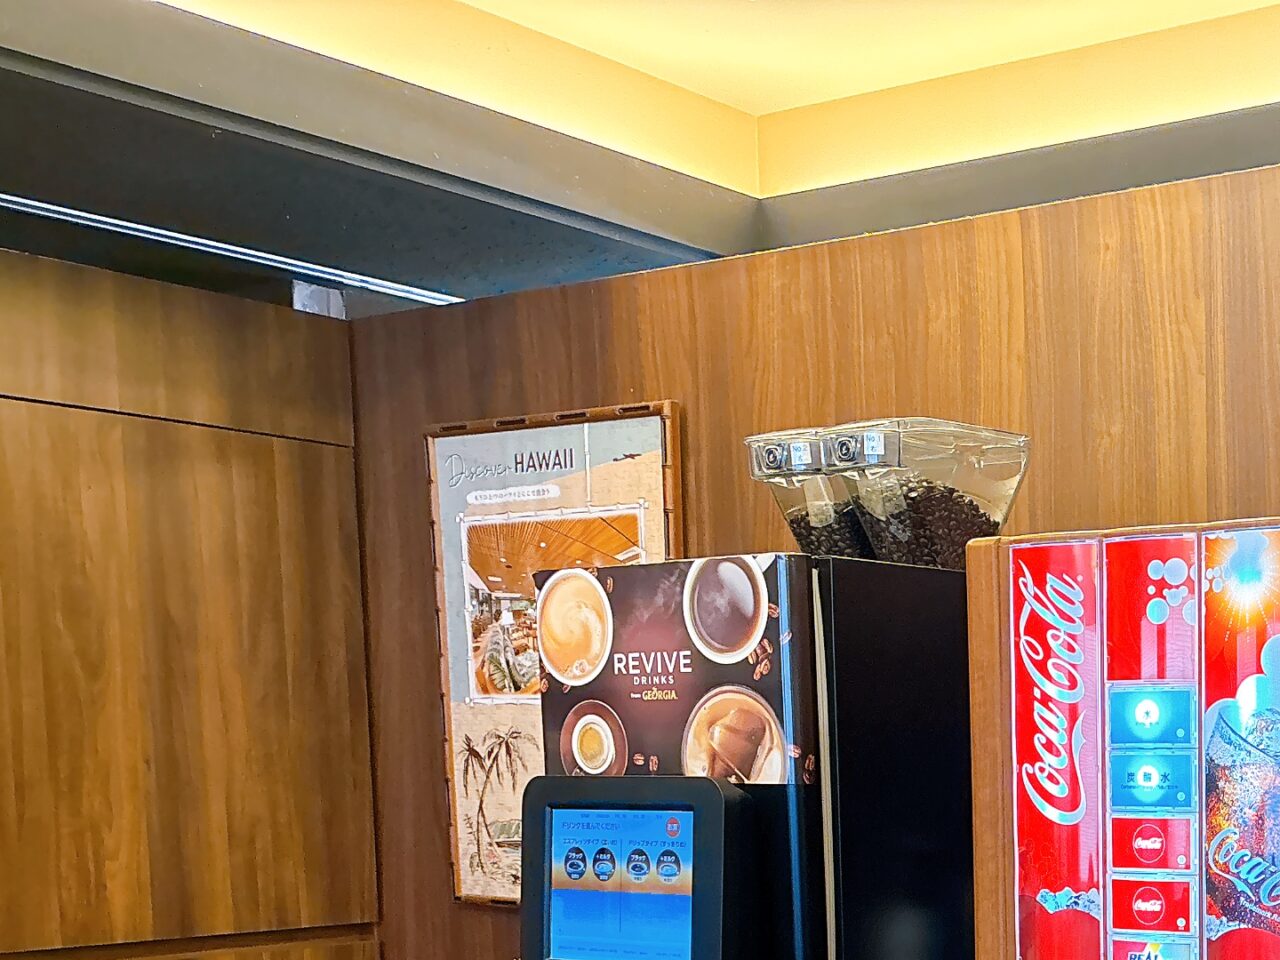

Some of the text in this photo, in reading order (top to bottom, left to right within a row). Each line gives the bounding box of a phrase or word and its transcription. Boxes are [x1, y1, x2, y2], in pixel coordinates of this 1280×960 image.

[445, 448, 574, 488] Discover HAWAII
[613, 650, 692, 675] REVIVE
[633, 675, 675, 685] DRINKS
[1019, 559, 1087, 826] Coca-Cola
[642, 686, 678, 700] GEORGIA
